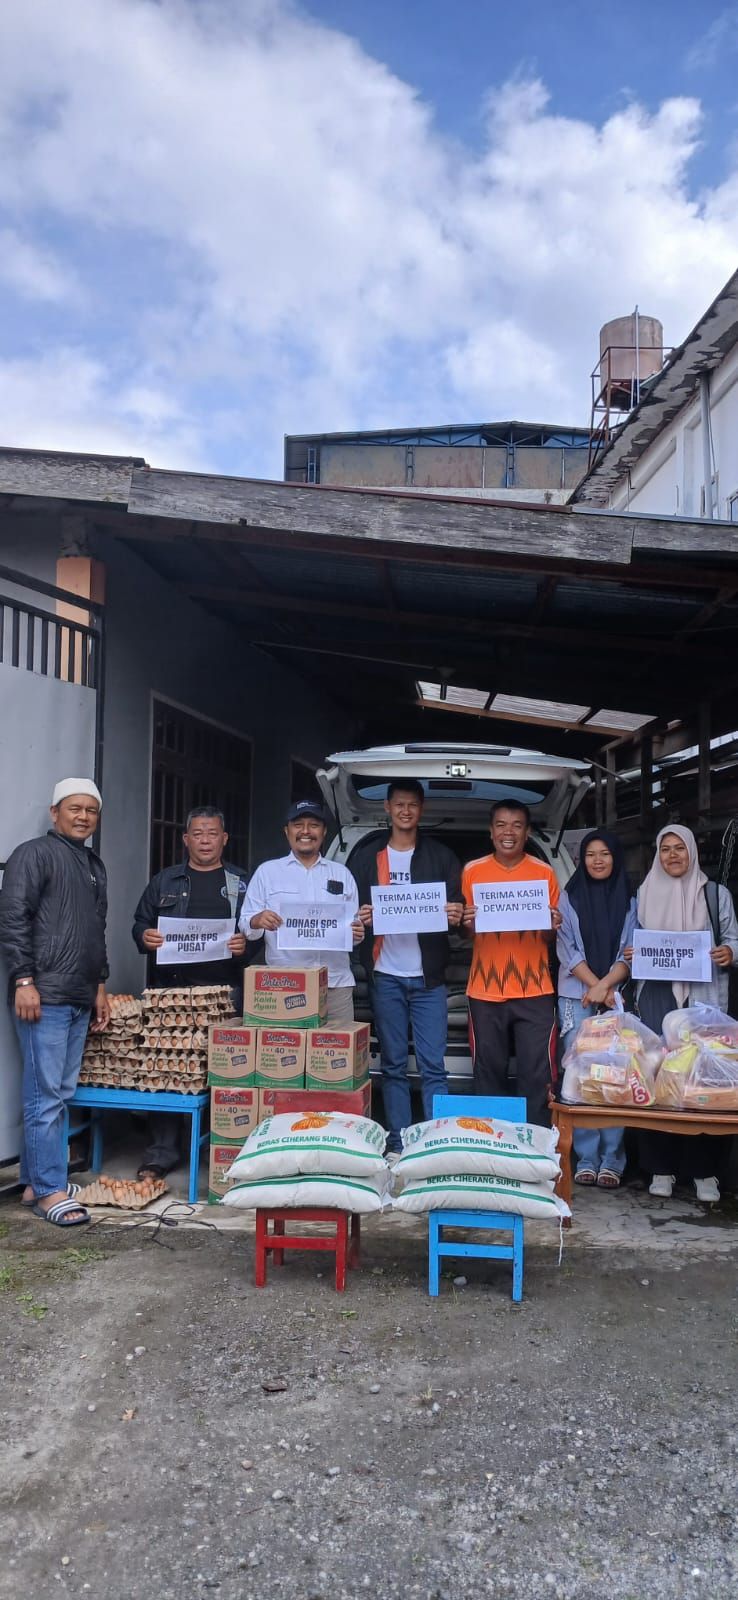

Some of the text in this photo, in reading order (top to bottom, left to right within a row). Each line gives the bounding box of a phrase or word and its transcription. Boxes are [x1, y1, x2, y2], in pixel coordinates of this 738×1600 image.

[378, 891, 441, 902] TERIMA KASIH
[480, 889, 544, 900] TERIMA KASIH
[381, 905, 440, 915] DEWAN PERS
[483, 902, 542, 913] DEWAN PERS
[286, 918, 338, 929] DONASI SPS
[165, 932, 218, 942] DONASI SPS
[297, 928, 326, 938] PUSAT
[177, 942, 206, 952] PUSAT
[641, 947, 694, 958] DONASI SPS
[652, 958, 682, 968] PUSAT
[325, 1049, 335, 1057] 40
[257, 1135, 347, 1149] BERAS CIHERANG SUPER
[424, 1136, 519, 1150] BERAS CIHERANG SUPER
[427, 1175, 521, 1188] BERAS CIHERANG SUPER
